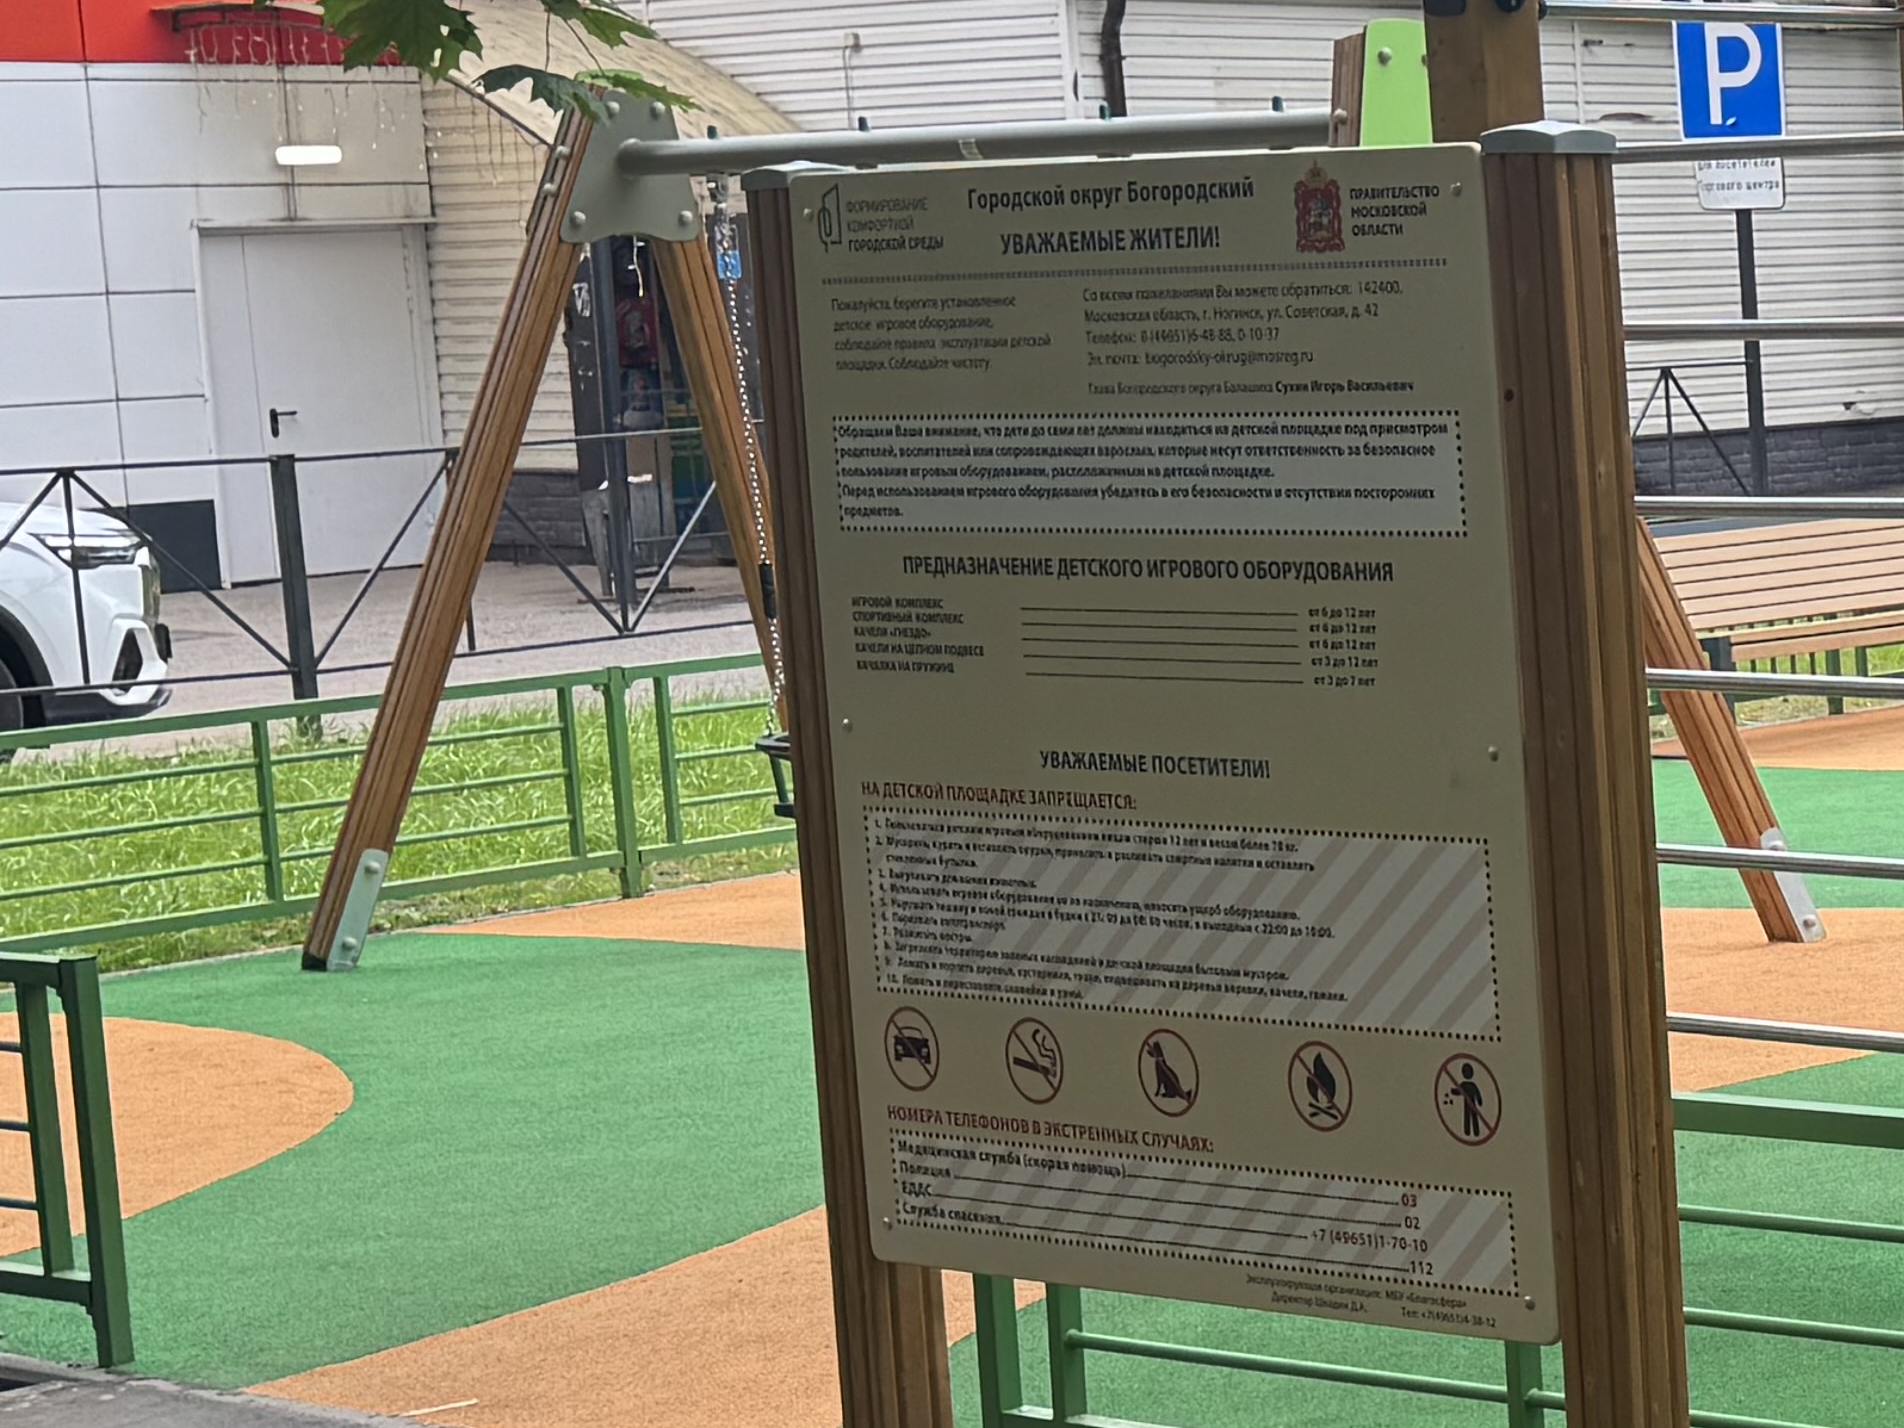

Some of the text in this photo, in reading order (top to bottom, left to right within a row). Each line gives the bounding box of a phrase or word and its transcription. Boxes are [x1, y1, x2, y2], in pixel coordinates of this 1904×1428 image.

[1704, 22, 1762, 125] P
[967, 176, 1254, 214] Городской округ Богородский
[1349, 184, 1440, 200] ПРАВИТЕЛЬСТВО
[846, 196, 929, 214] ФОРМИРОВАНИЕ
[1350, 201, 1427, 218] МОСКОВСКОЙ
[1351, 222, 1404, 237] ОБЛАСТИ
[848, 234, 944, 253] ГОРОДСКОЙ СРЕДЫ
[1001, 225, 1220, 255] УВАЖАЕМЫЕ ЖИТЕЛИ!
[837, 424, 894, 439] Обращаем
[1231, 422, 1279, 438] детской
[1280, 424, 1343, 437] площадке
[1344, 423, 1368, 438] под
[1368, 423, 1449, 437] присмотром
[898, 444, 972, 458] воспитателей
[1209, 445, 1243, 459] несут
[1244, 445, 1346, 457] ответственность
[1362, 443, 1436, 457] безопасное
[1163, 465, 1210, 479] детской
[1210, 466, 1275, 479] площадке.
[966, 486, 1017, 499] игрового
[1190, 485, 1273, 499] безопасности
[1353, 487, 1435, 501] посторонних
[903, 555, 1394, 583] ПРЕДНАЗНАЧЕНИЕ ДЕТСКОГО ИГРОВОГО ОБОРУДОВАНИЯ
[851, 595, 944, 609] ИГРОВОЙ КОМПЛЕКС
[852, 610, 965, 625] СПОРТИВНЫЙ КОМПЛЕКС
[1040, 750, 1270, 779] УВАЖАЕМЫЕ ПОСЕТИТЕЛИ!
[861, 780, 1137, 810] НА ДЕТСКОЙ ПЛОЩАДКЕ ЗАПРЕЩАЕТСЯ:
[887, 1104, 1214, 1153] НОМЕРА ТЕЛЕФОНОВ В ЭКСТРЕННЫХ СЛУЧАЯХ:
[897, 1139, 977, 1161] Медицинская
[978, 1150, 1021, 1167] служба
[1023, 1152, 1071, 1172] (скорая
[1401, 1192, 1418, 1208] 03
[899, 1159, 1420, 1230] Полиция 02
[902, 1200, 946, 1219] Служба
[1409, 1259, 1433, 1276] 112
